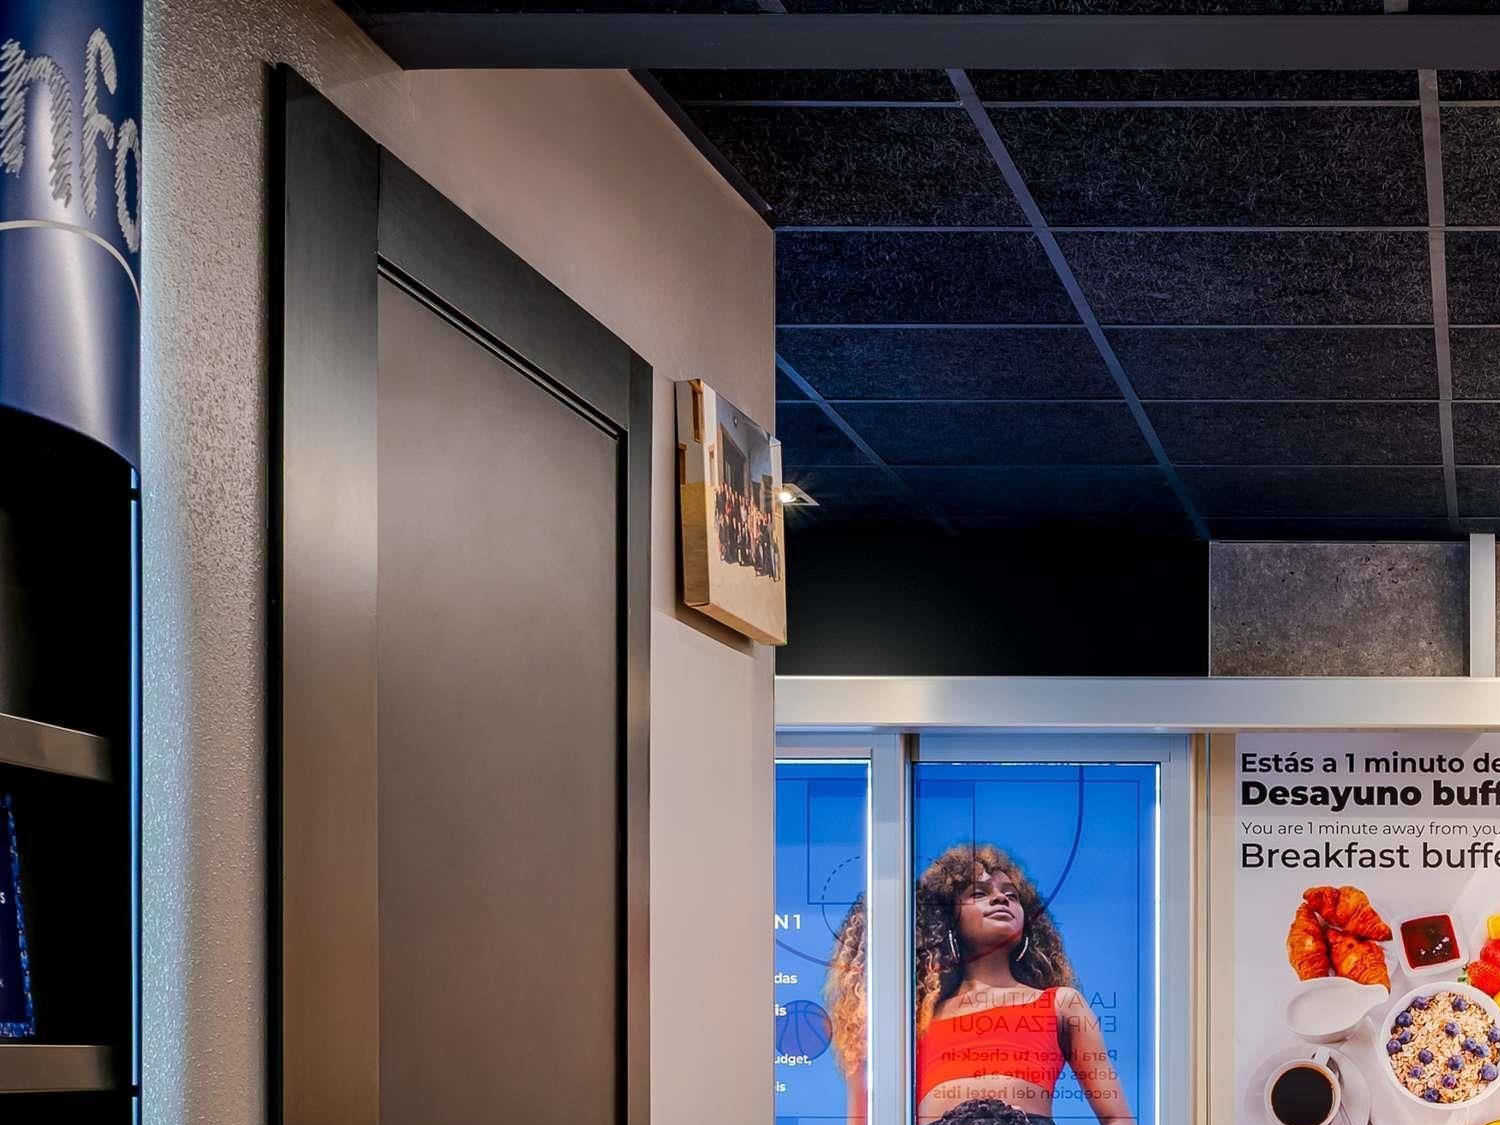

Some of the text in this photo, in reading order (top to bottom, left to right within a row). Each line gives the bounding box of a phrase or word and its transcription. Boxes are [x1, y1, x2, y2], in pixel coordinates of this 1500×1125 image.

[1242, 752, 1314, 773] Estás
[1322, 757, 1337, 773] a
[1345, 753, 1355, 773] 1
[1365, 751, 1465, 773] minuto
[1242, 781, 1422, 812] Desayuno
[1242, 822, 1273, 835] You
[1278, 824, 1304, 835] are
[1307, 822, 1313, 834] 1
[1319, 821, 1378, 835] minute
[1382, 824, 1425, 838] away
[1430, 821, 1468, 835] from
[1242, 842, 1410, 868] Breakfast
